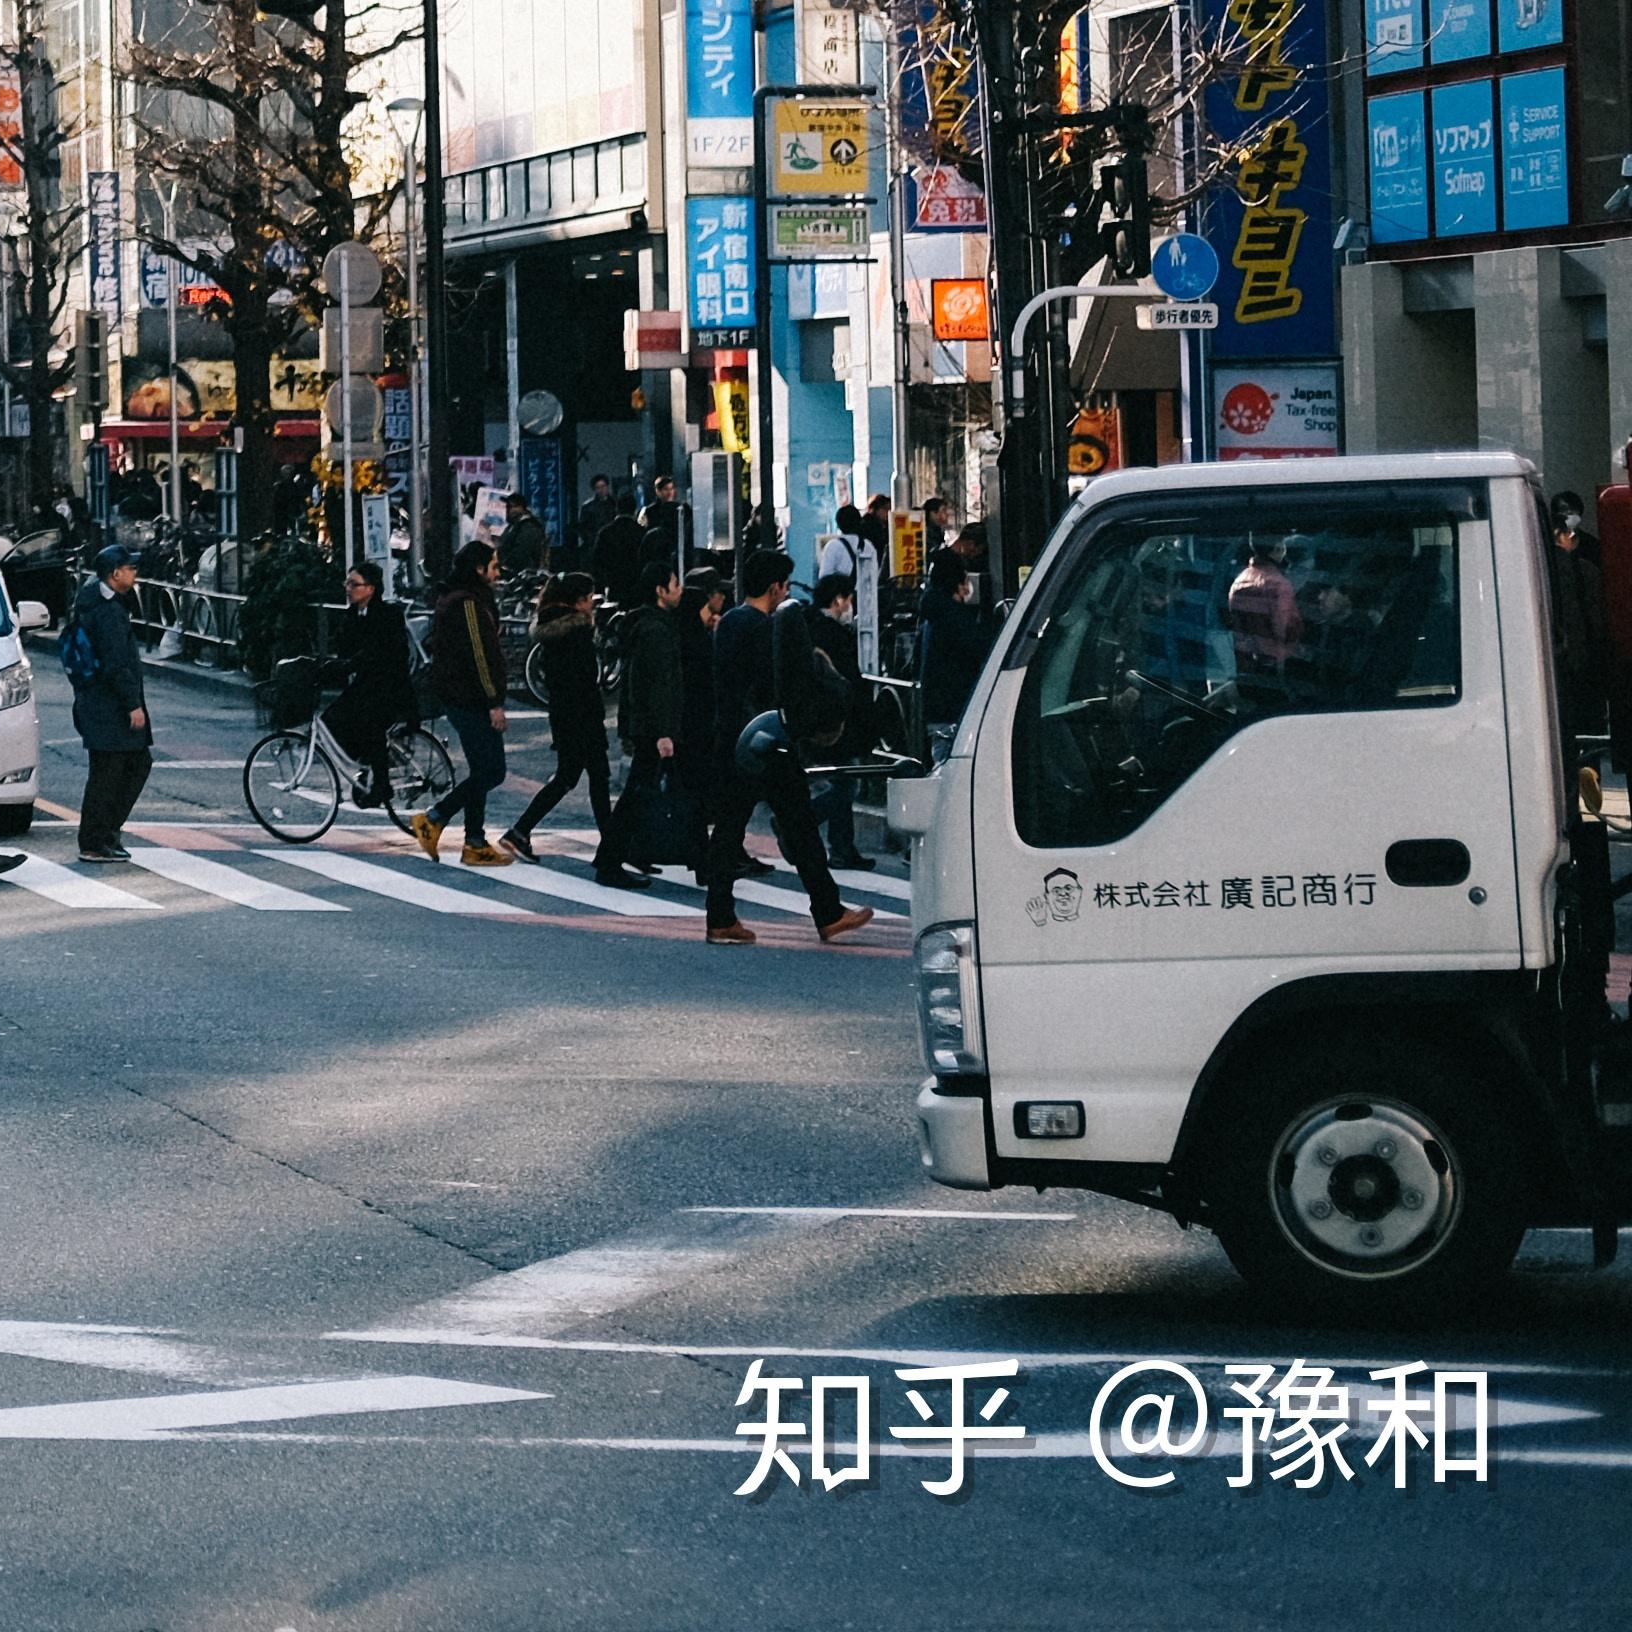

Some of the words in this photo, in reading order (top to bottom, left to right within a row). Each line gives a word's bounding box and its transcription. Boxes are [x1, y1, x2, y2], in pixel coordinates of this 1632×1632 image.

[1523, 104, 1560, 123] SERVICE
[692, 133, 751, 155] 1F/2F
[1436, 119, 1492, 155] ソフマップ
[1522, 123, 1561, 144] SUPPORT
[1444, 169, 1485, 197] Sofmap
[722, 203, 751, 316] 新宿南口
[695, 218, 723, 326] アイ眼科
[1155, 310, 1213, 324] 歩行者優先
[697, 329, 750, 347] 地下1F
[1285, 403, 1337, 417] Tax-free
[1304, 418, 1337, 432] Shop
[1092, 877, 1213, 911] 株式会社
[1220, 872, 1377, 911] 廣記商行
